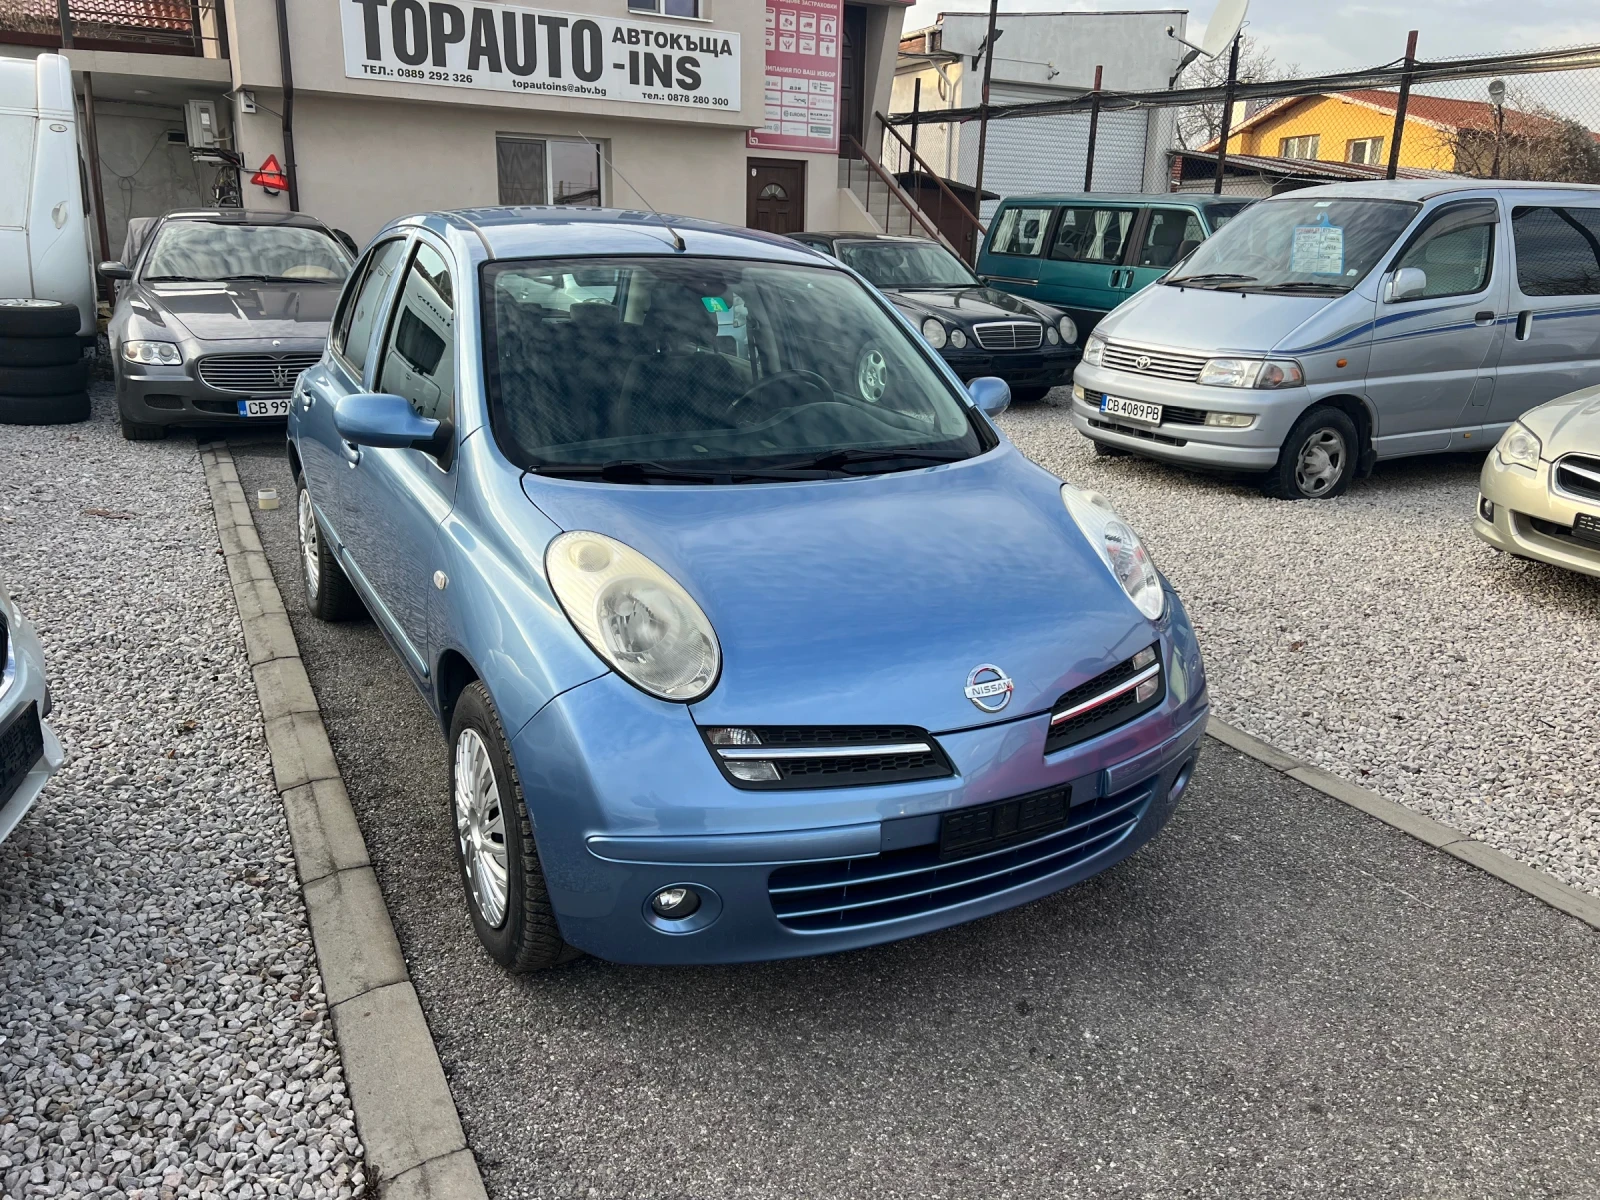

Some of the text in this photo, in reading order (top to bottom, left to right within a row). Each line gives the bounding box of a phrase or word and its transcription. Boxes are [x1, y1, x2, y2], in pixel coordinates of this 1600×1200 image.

[352, 0, 701, 91] TOPAUTO -INS
[612, 27, 733, 58] АВТОКЪЩА
[361, 64, 473, 83] ТЕЛ.: 0889 292 326
[817, 70, 836, 78] ИЗБОР
[512, 79, 607, 96] topautoins@abv.bg
[642, 92, 729, 106] тел.: 0878 280 300
[249, 401, 291, 414] CB 99
[1107, 399, 1160, 420] CB 4089 PB
[972, 681, 1010, 695] NISSAN
